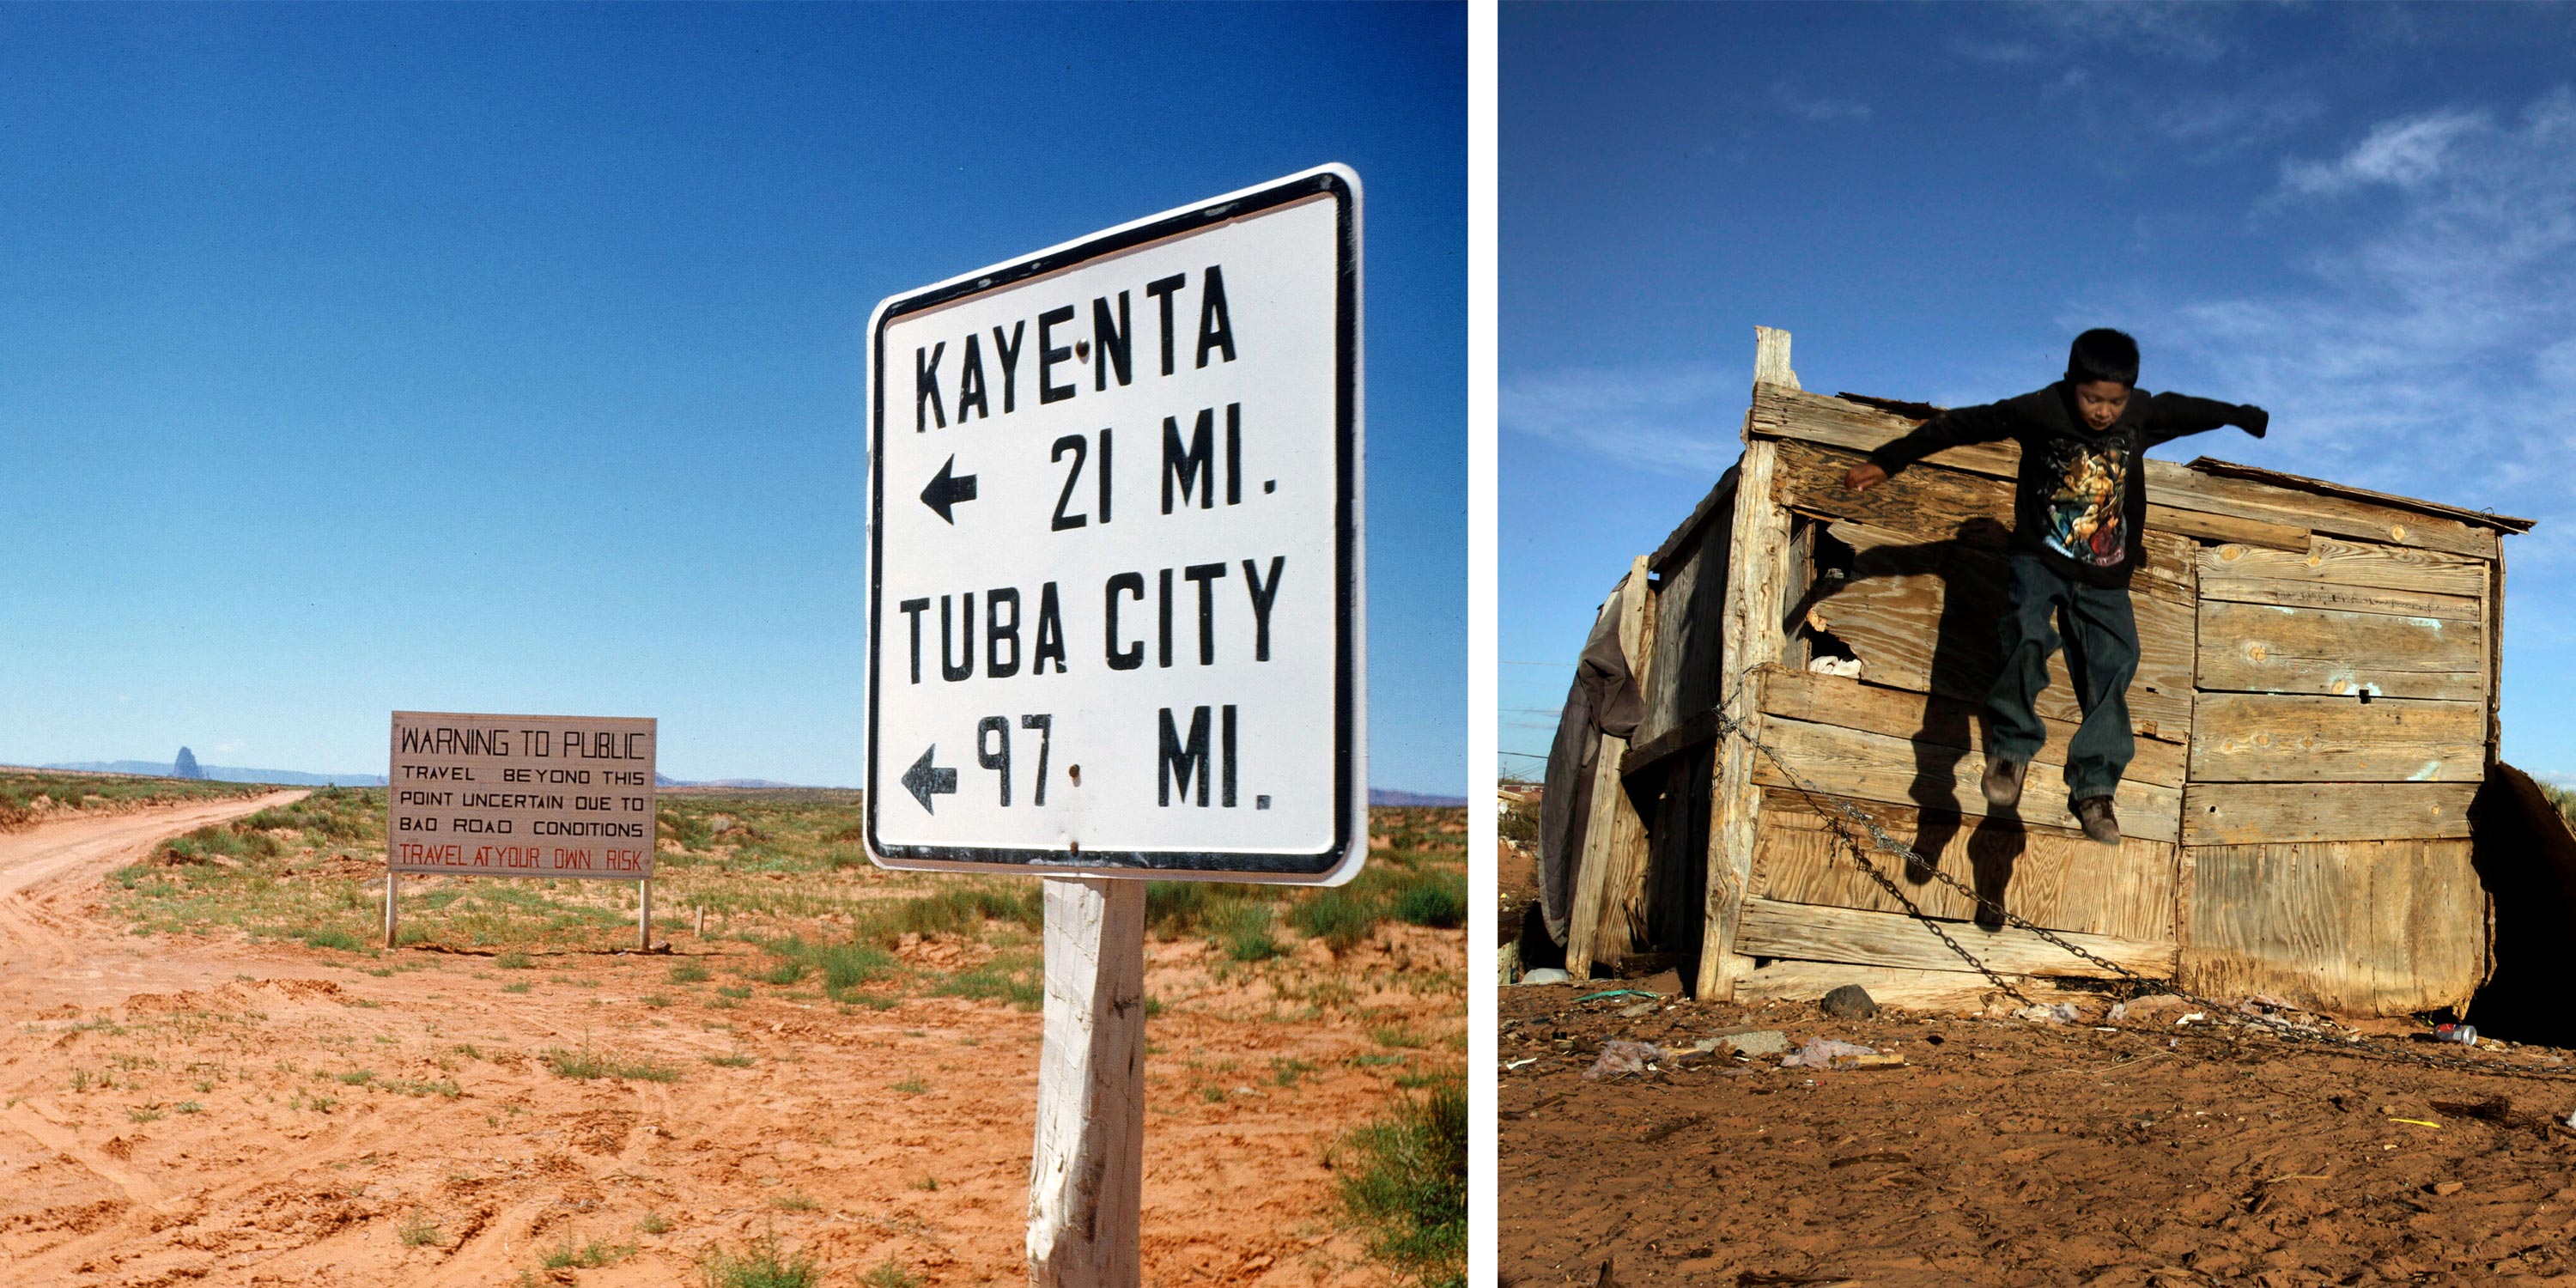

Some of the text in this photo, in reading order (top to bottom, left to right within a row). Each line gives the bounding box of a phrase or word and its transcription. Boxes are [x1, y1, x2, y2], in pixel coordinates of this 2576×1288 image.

[915, 264, 1236, 434] KAYENTA
[1050, 402, 1278, 532] 21 MI.
[900, 556, 1285, 685] TUBA CITY
[402, 727, 646, 760] WARNING TO PUBLIC
[977, 704, 1272, 811] 97 MI.
[402, 765, 645, 786] TRAVEL BEYOND THIS
[400, 791, 644, 811] POINT UNCERTAIN DUE TO
[399, 817, 643, 838] BAD ROAD CONDITIONS
[399, 843, 642, 872] TRAVEL AT YOUR OWN RISK
